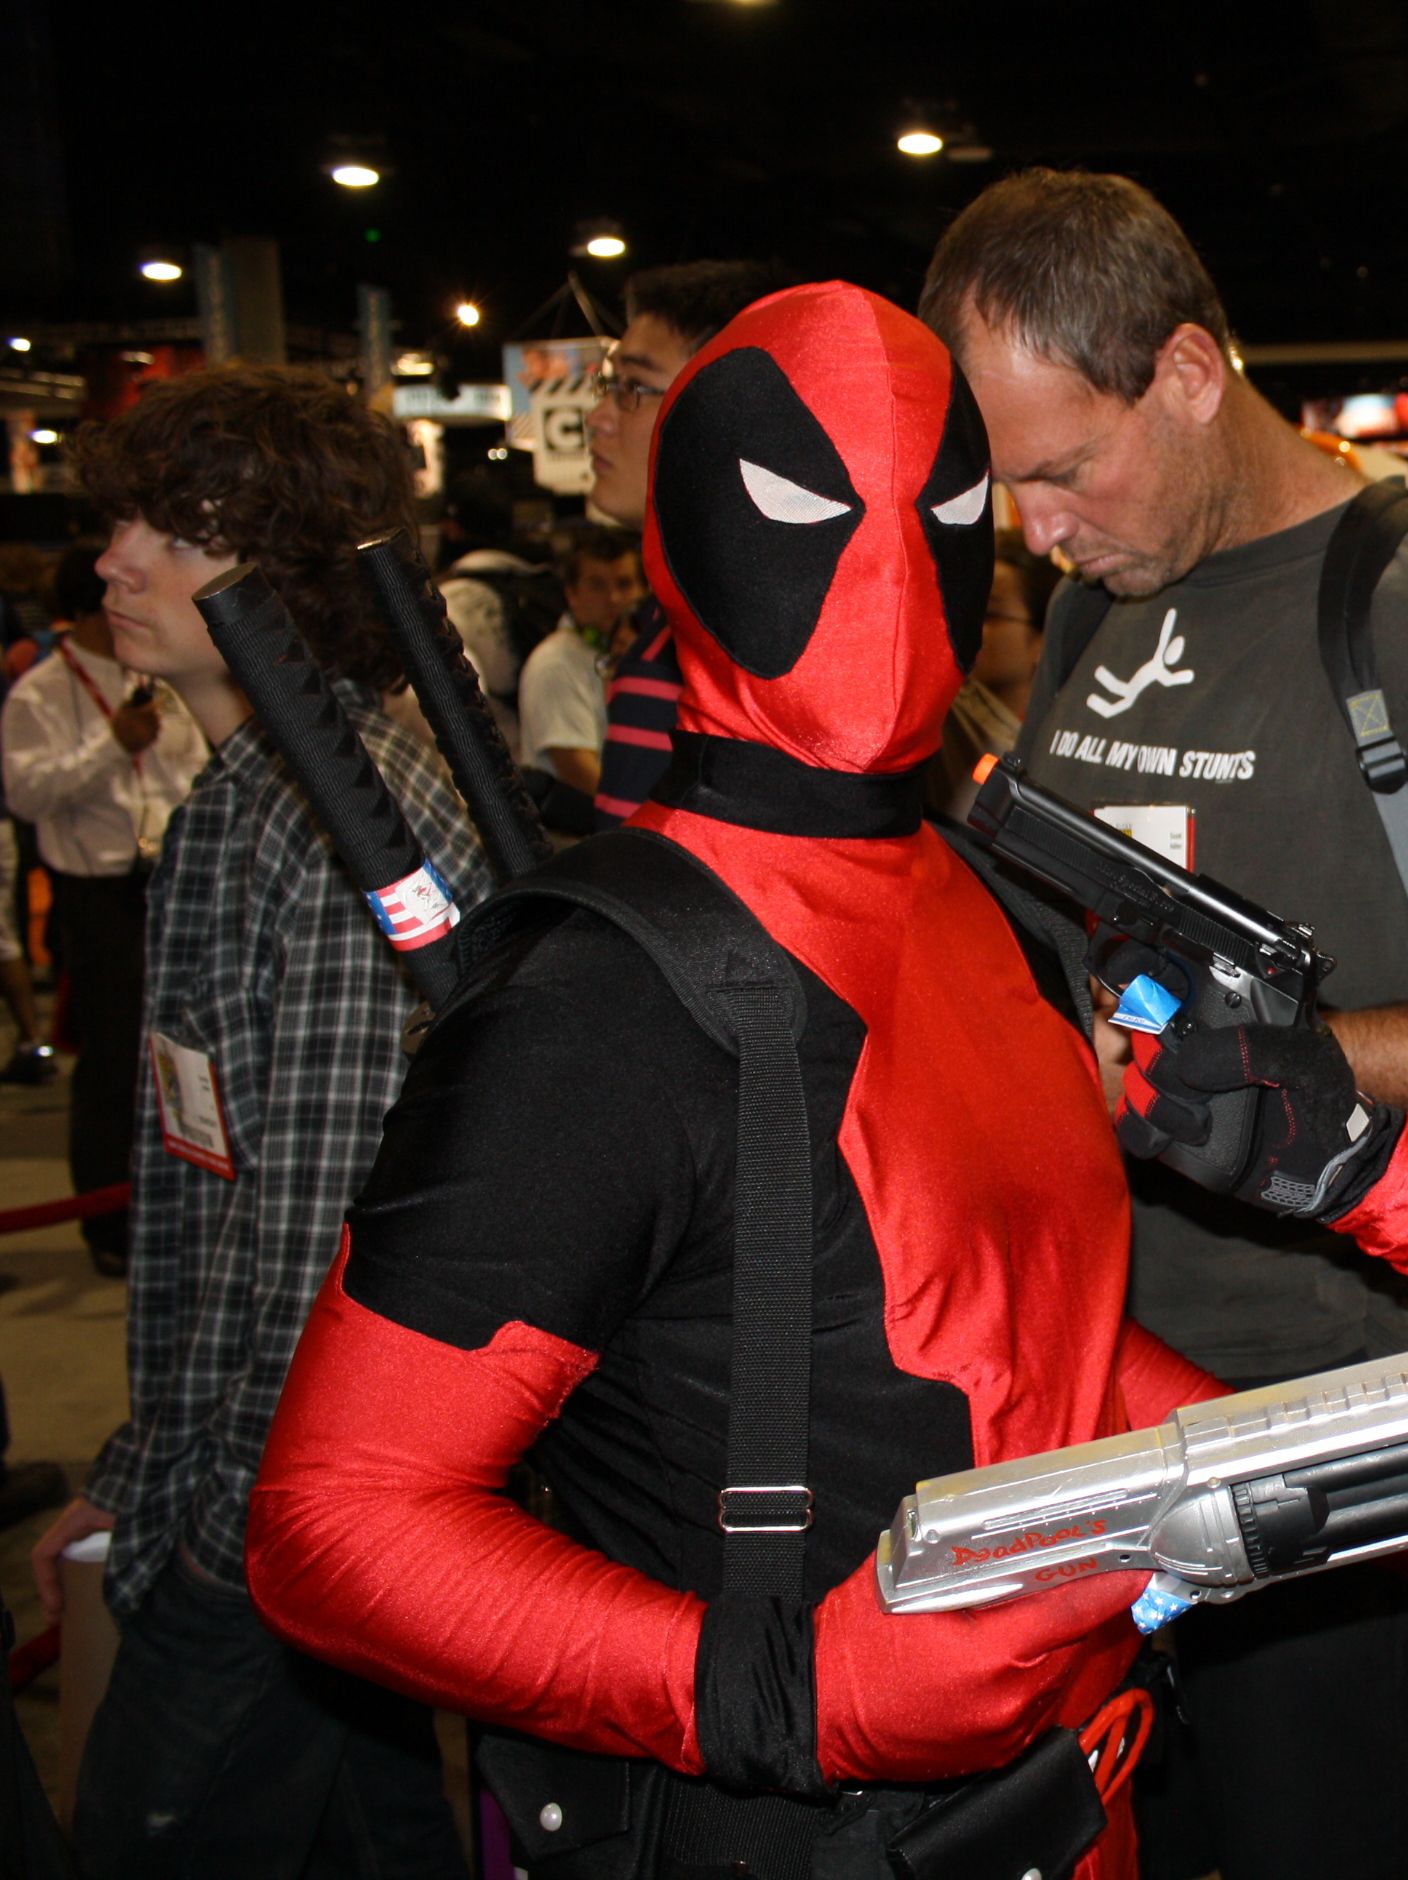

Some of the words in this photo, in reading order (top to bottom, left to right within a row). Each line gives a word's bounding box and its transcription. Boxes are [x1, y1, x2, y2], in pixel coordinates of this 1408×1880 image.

[1050, 729, 1061, 754] I
[1056, 730, 1080, 758] DO
[1074, 735, 1107, 764] ALL
[1105, 740, 1139, 771] MY
[1137, 745, 1178, 776] OWN
[1179, 750, 1256, 780] STUNTS
[1035, 1556, 1097, 1582] GUN
